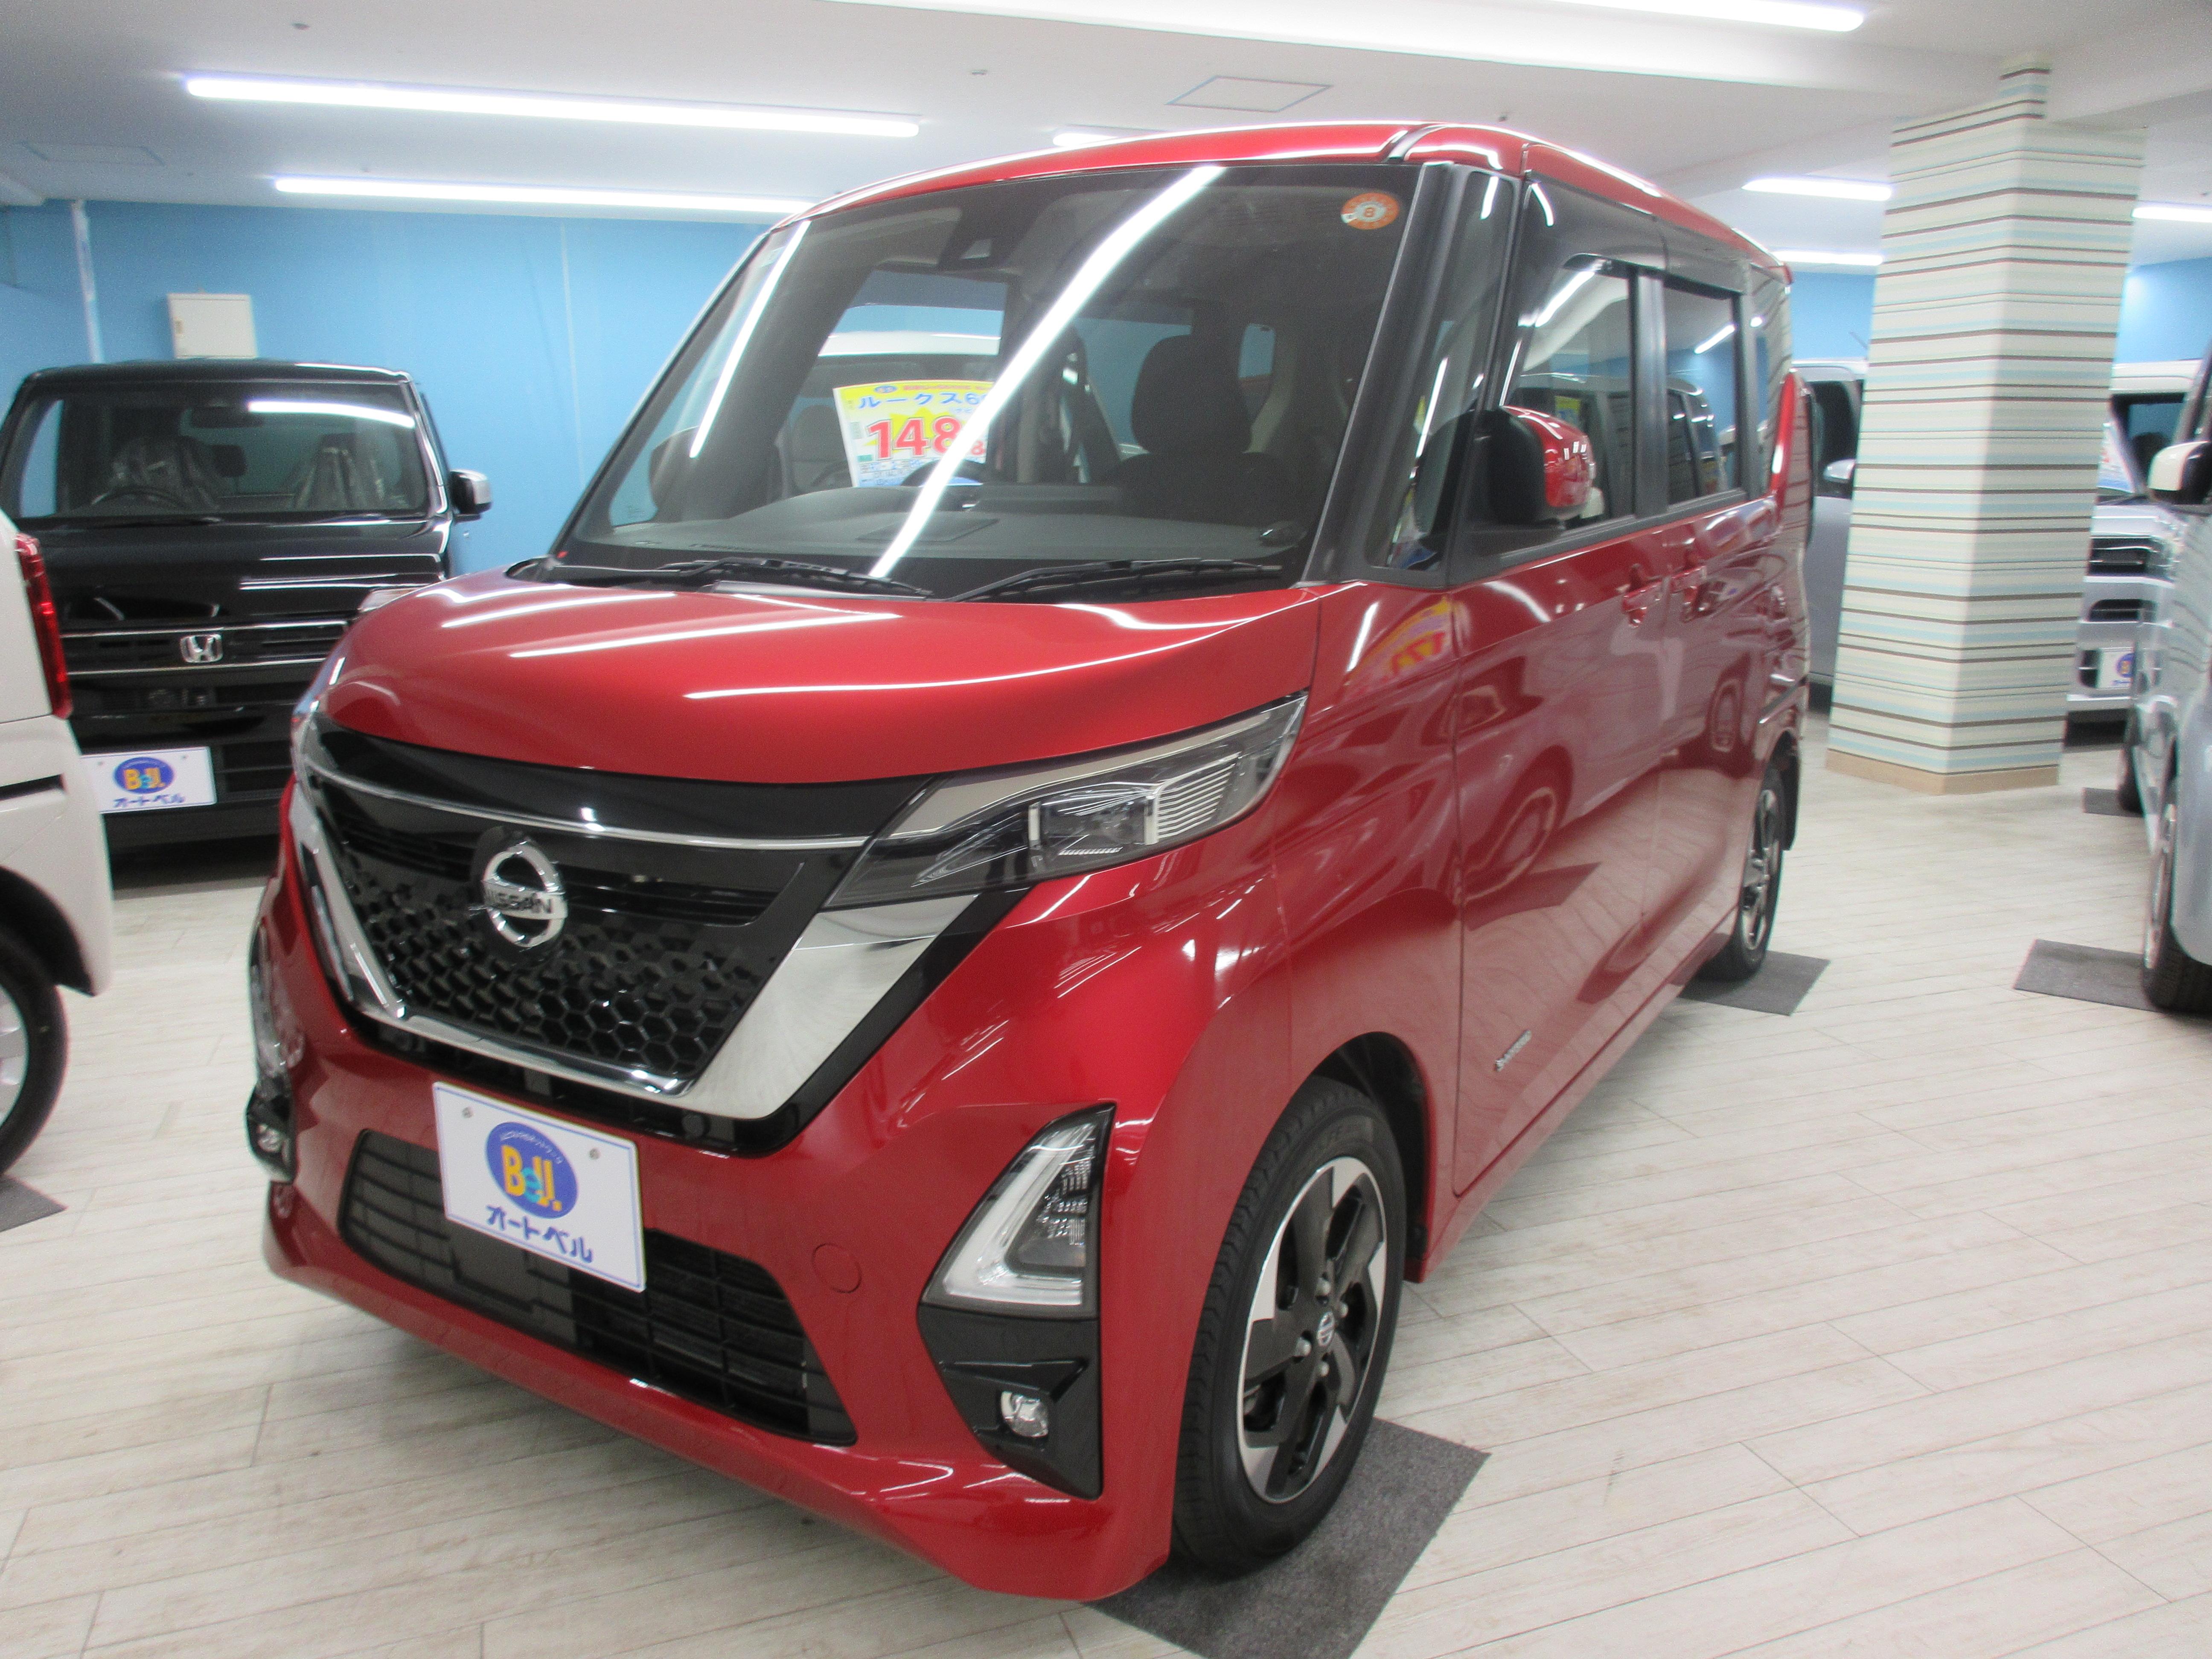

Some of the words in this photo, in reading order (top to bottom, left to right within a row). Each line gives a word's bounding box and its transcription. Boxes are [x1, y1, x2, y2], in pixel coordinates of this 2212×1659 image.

[486, 1205, 593, 1263] オートベル
